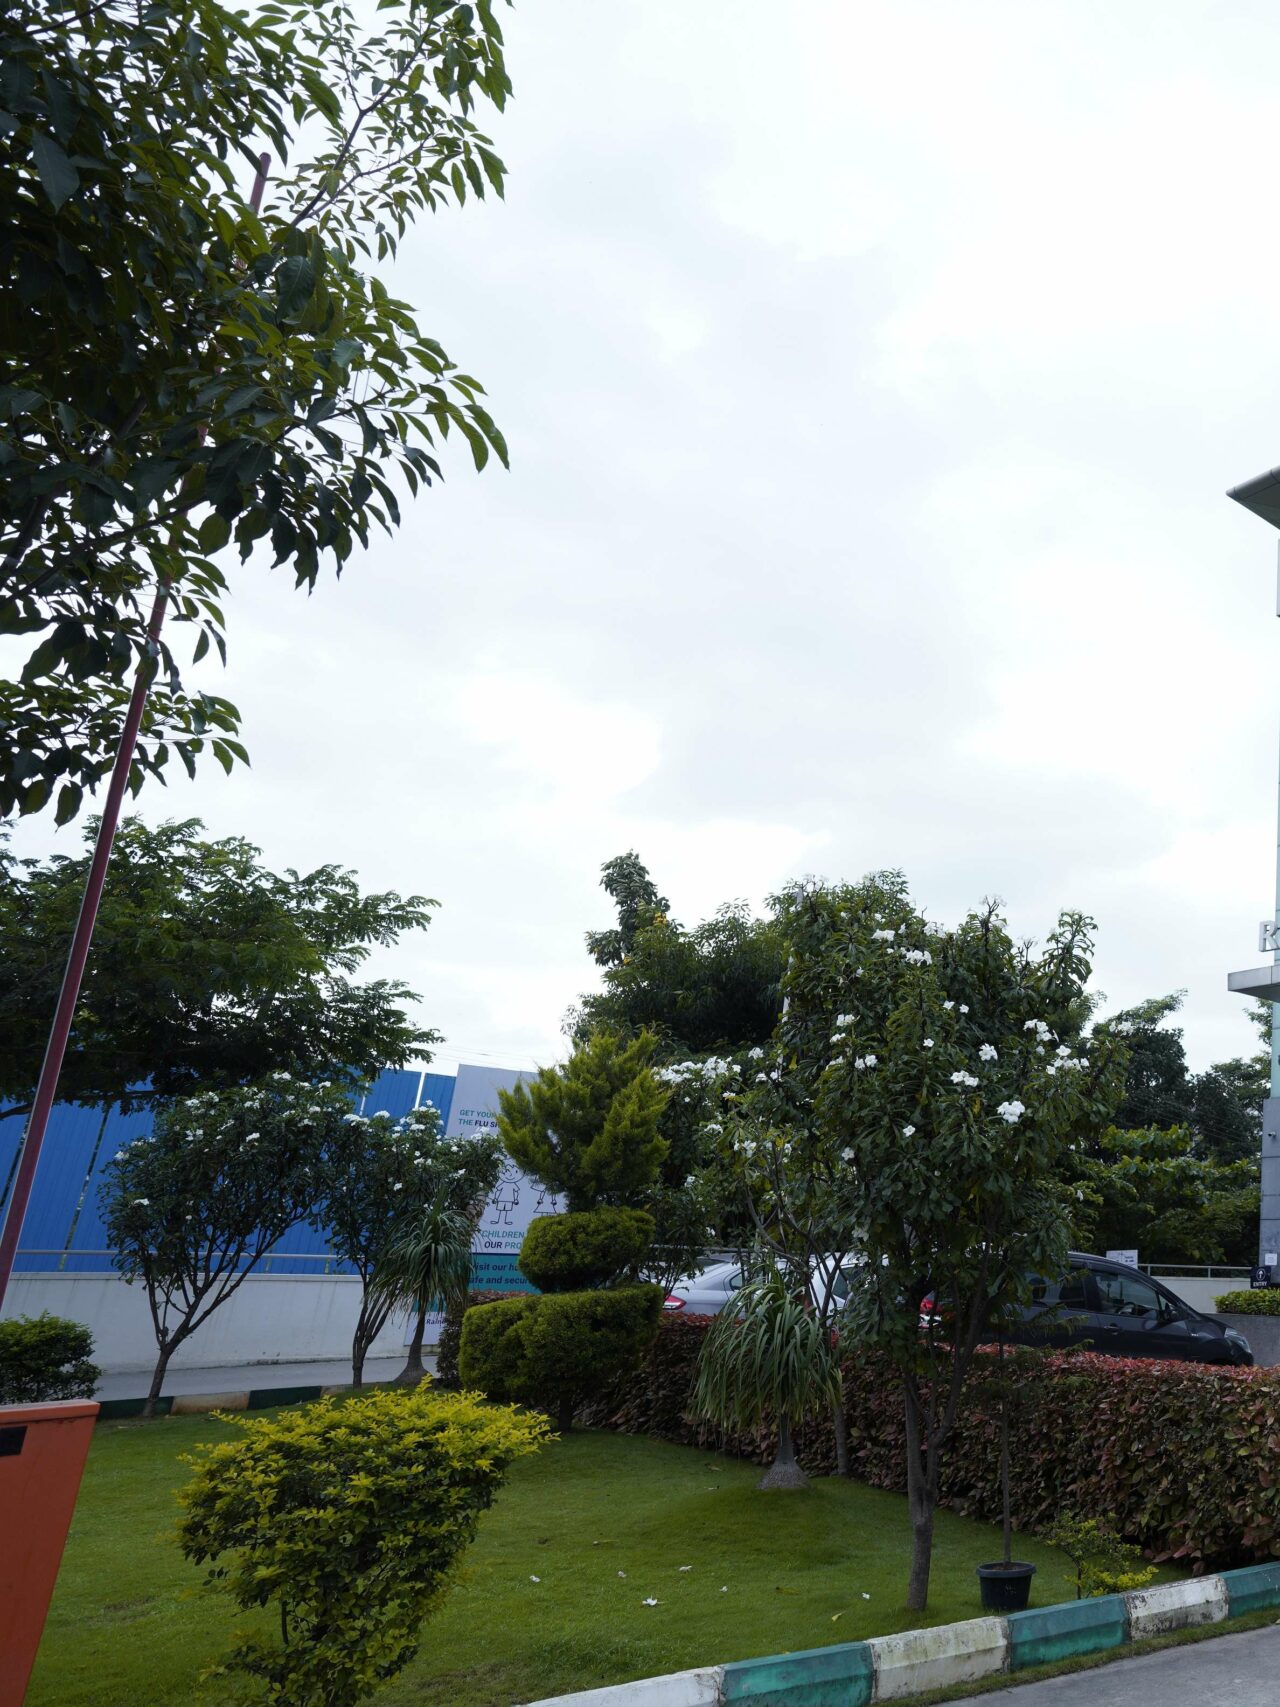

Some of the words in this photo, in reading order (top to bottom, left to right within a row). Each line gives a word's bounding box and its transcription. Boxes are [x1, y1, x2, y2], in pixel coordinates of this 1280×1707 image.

[459, 1109, 474, 1117] GET
[458, 1118, 473, 1126] THE
[474, 1119, 488, 1127] FLU
[481, 1229, 525, 1239] CHILDREN
[484, 1240, 502, 1249] OUR
[504, 1241, 521, 1249] PRO
[486, 1276, 503, 1284] and
